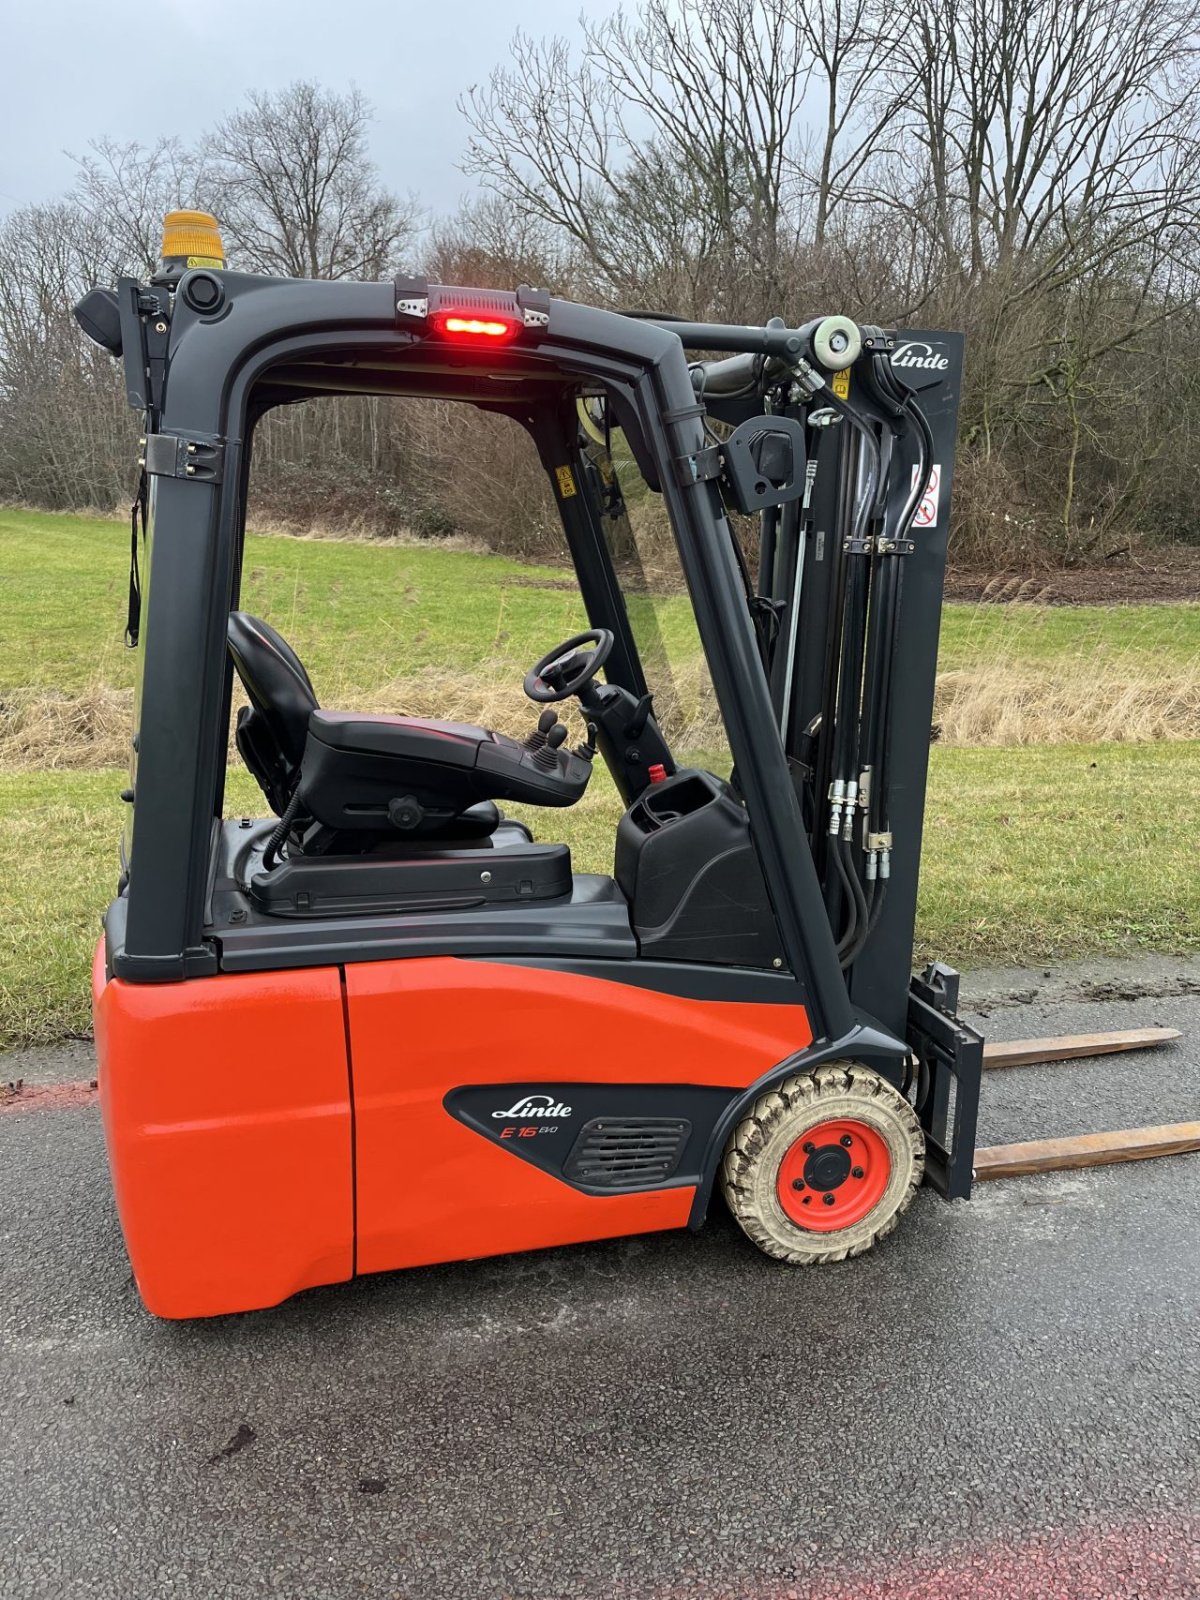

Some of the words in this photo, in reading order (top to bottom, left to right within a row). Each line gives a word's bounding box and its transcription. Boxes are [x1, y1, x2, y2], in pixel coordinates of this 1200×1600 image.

[891, 342, 949, 370] Linde
[491, 1095, 572, 1118] Linde
[500, 1127, 516, 1139] E
[518, 1126, 539, 1138] 16
